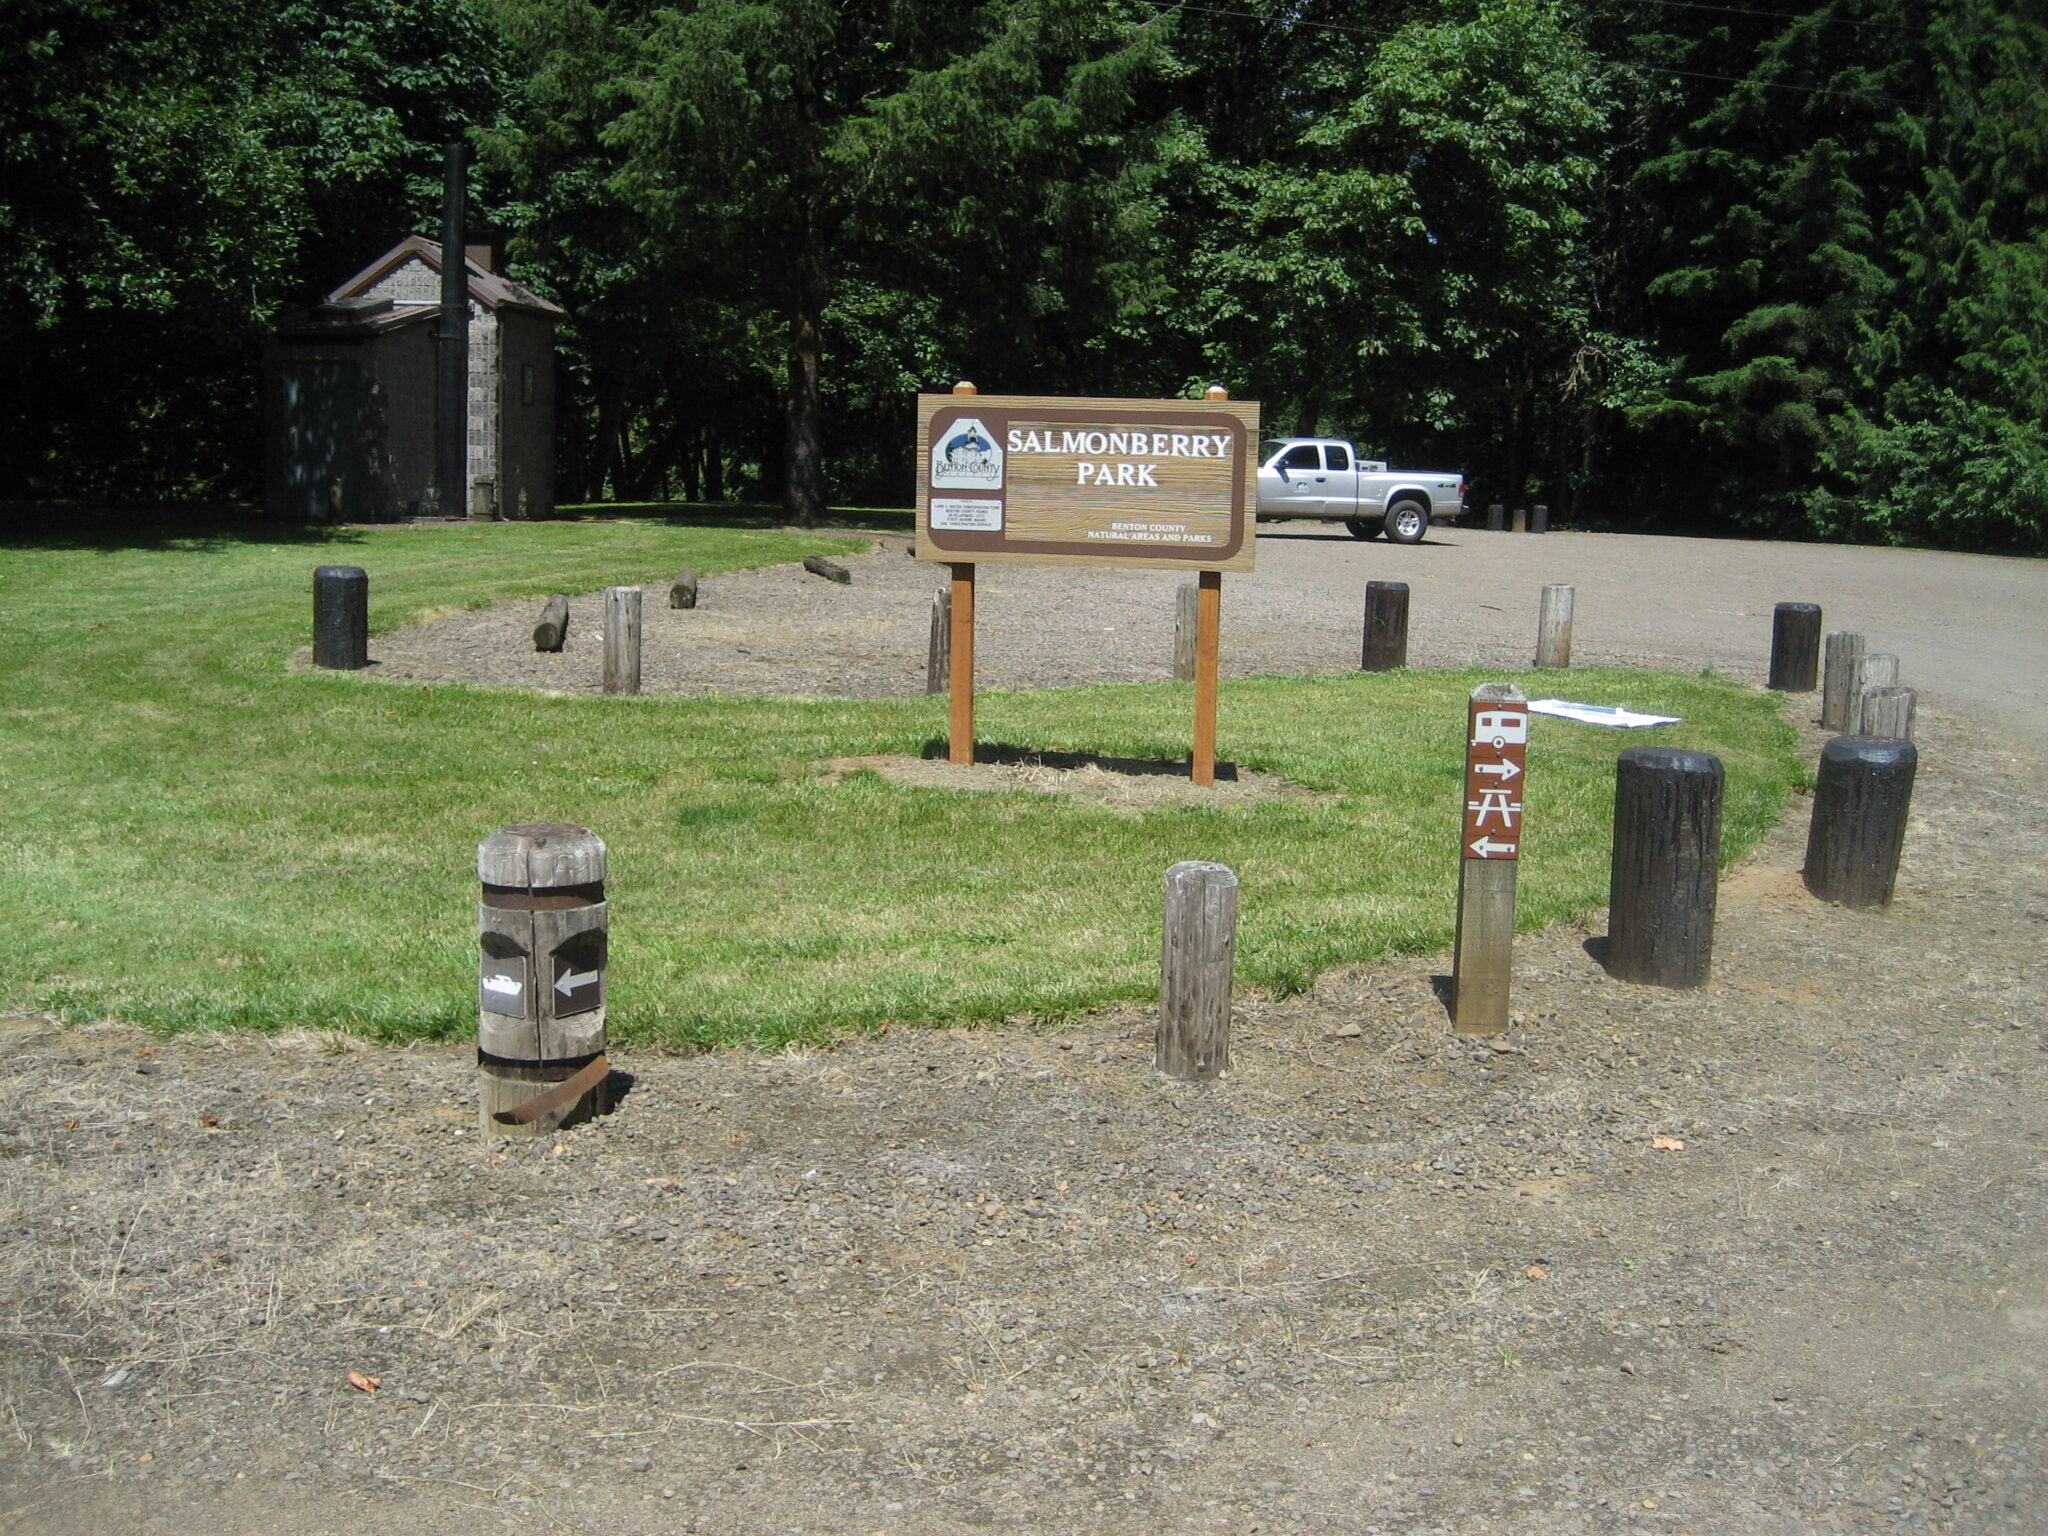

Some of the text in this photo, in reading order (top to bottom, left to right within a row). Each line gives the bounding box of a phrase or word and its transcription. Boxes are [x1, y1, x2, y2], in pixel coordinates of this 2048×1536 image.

[1007, 430, 1231, 458] SALMONBERRY
[1076, 462, 1159, 487] PARK
[1112, 522, 1186, 532] BENTON COUNTY
[1087, 531, 1212, 543] NATURAL AREAS AND PARKS
